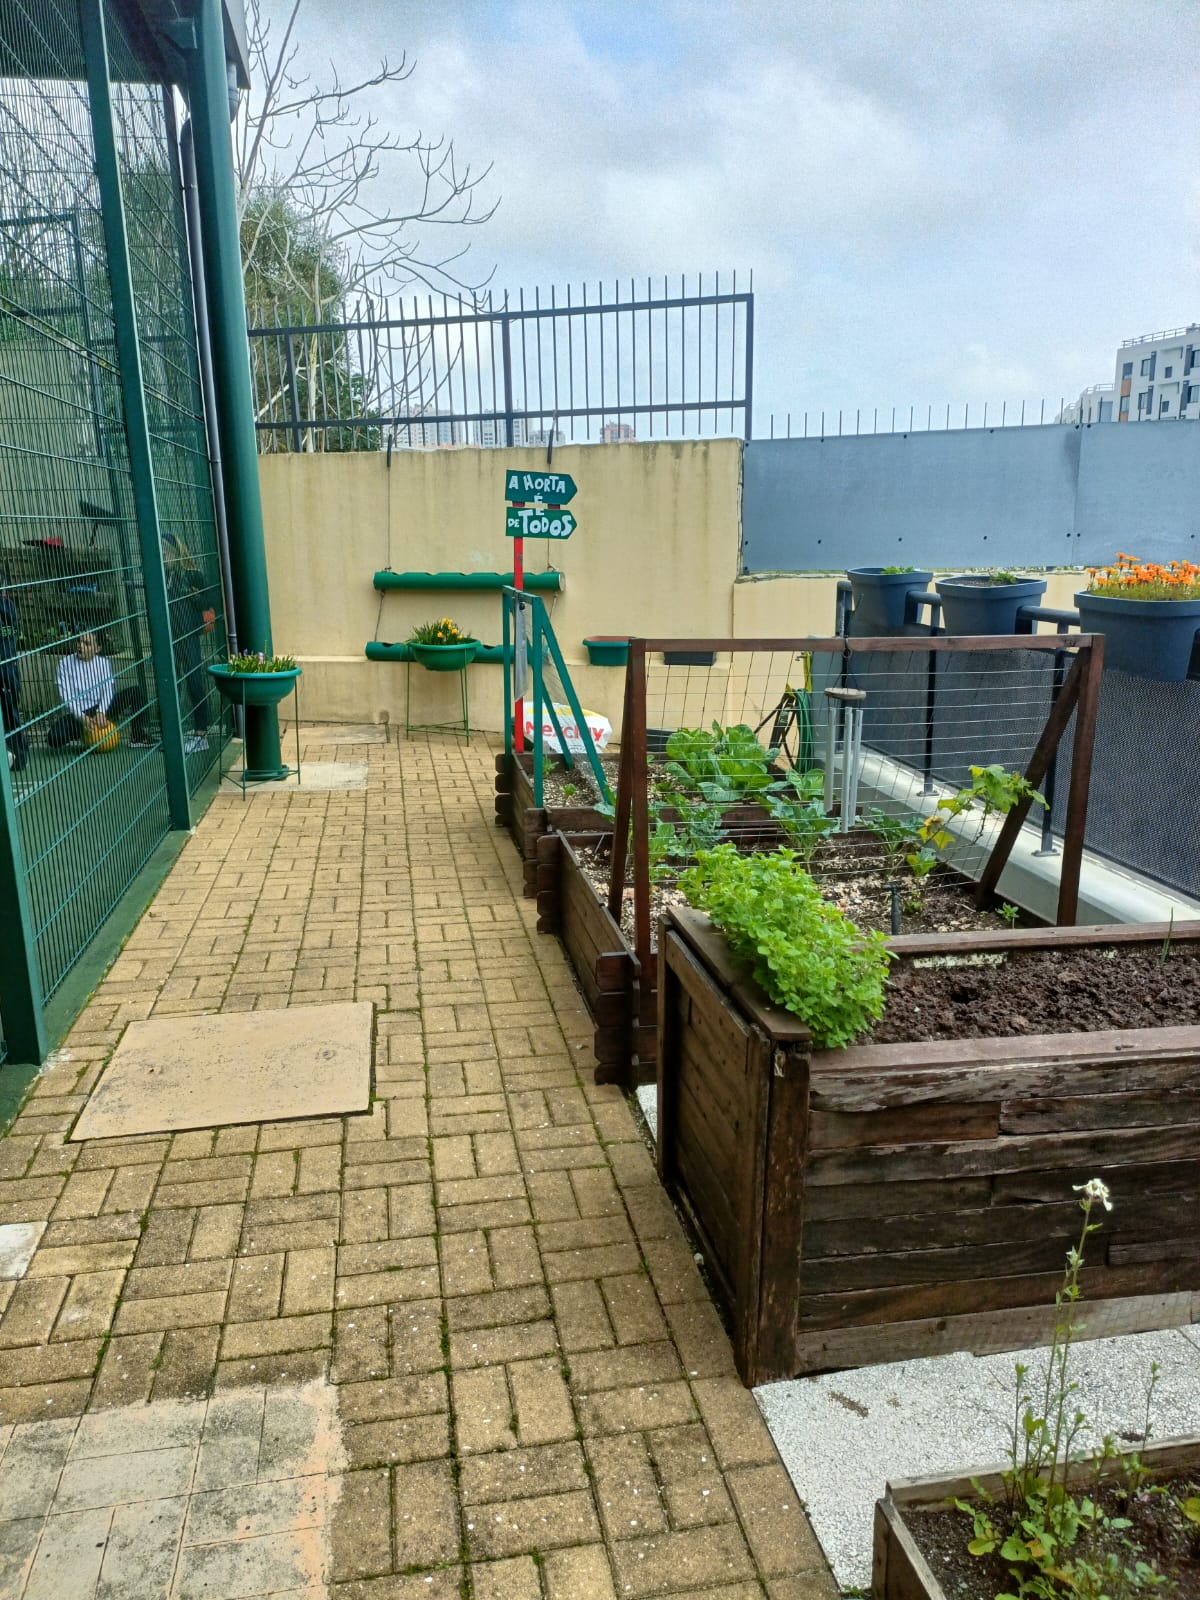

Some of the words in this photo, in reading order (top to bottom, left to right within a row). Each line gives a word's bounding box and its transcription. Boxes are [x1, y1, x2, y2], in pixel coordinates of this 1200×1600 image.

[508, 475, 519, 490] A
[522, 474, 566, 494] HORTA
[507, 518, 520, 528] DE
[518, 509, 573, 537] TODOS
[525, 720, 605, 742] Mecly
